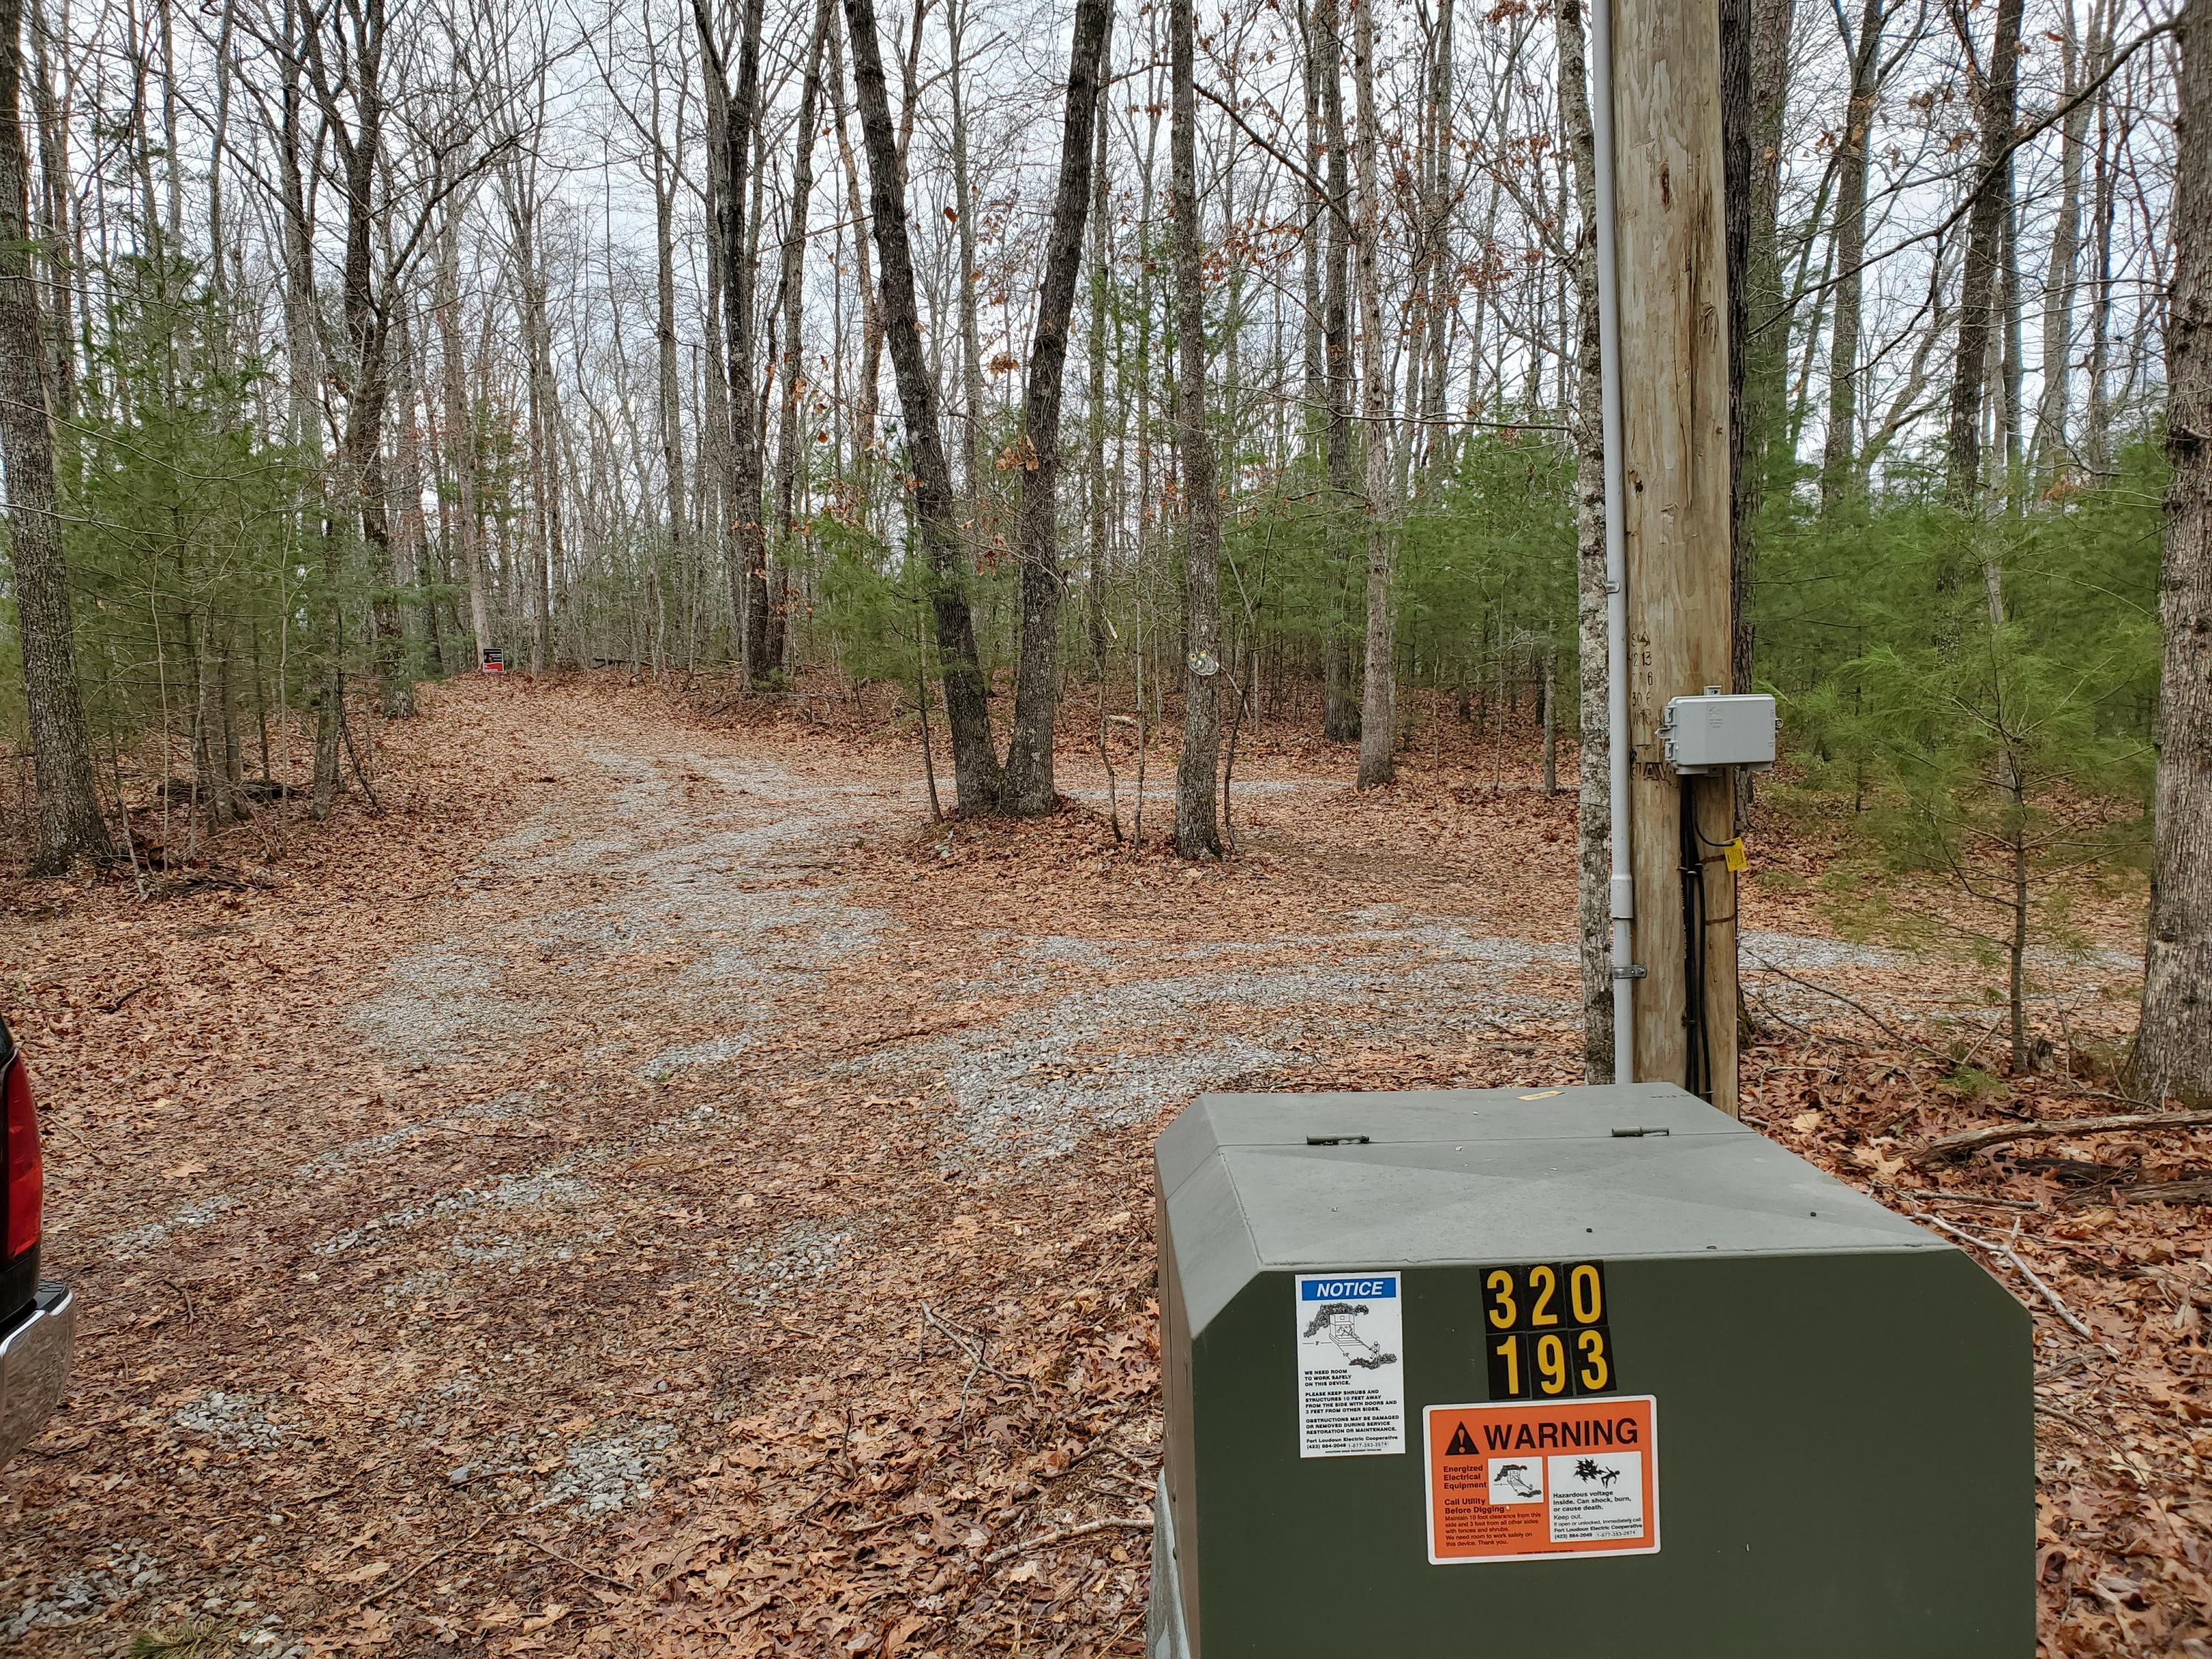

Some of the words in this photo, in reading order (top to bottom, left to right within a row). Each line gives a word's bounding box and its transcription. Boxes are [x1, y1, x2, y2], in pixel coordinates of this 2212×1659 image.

[1317, 1281, 1383, 1297] NOTICE
[1487, 1265, 1601, 1329] 320
[1497, 1329, 1608, 1395] 193
[1483, 1417, 1638, 1450] WARNING
[1443, 1464, 1484, 1473] Energized
[1444, 1473, 1481, 1481] Electrical
[1444, 1482, 1486, 1490] Equipment
[1462, 1498, 1486, 1506] Utility
[1473, 1506, 1505, 1514] Digging
